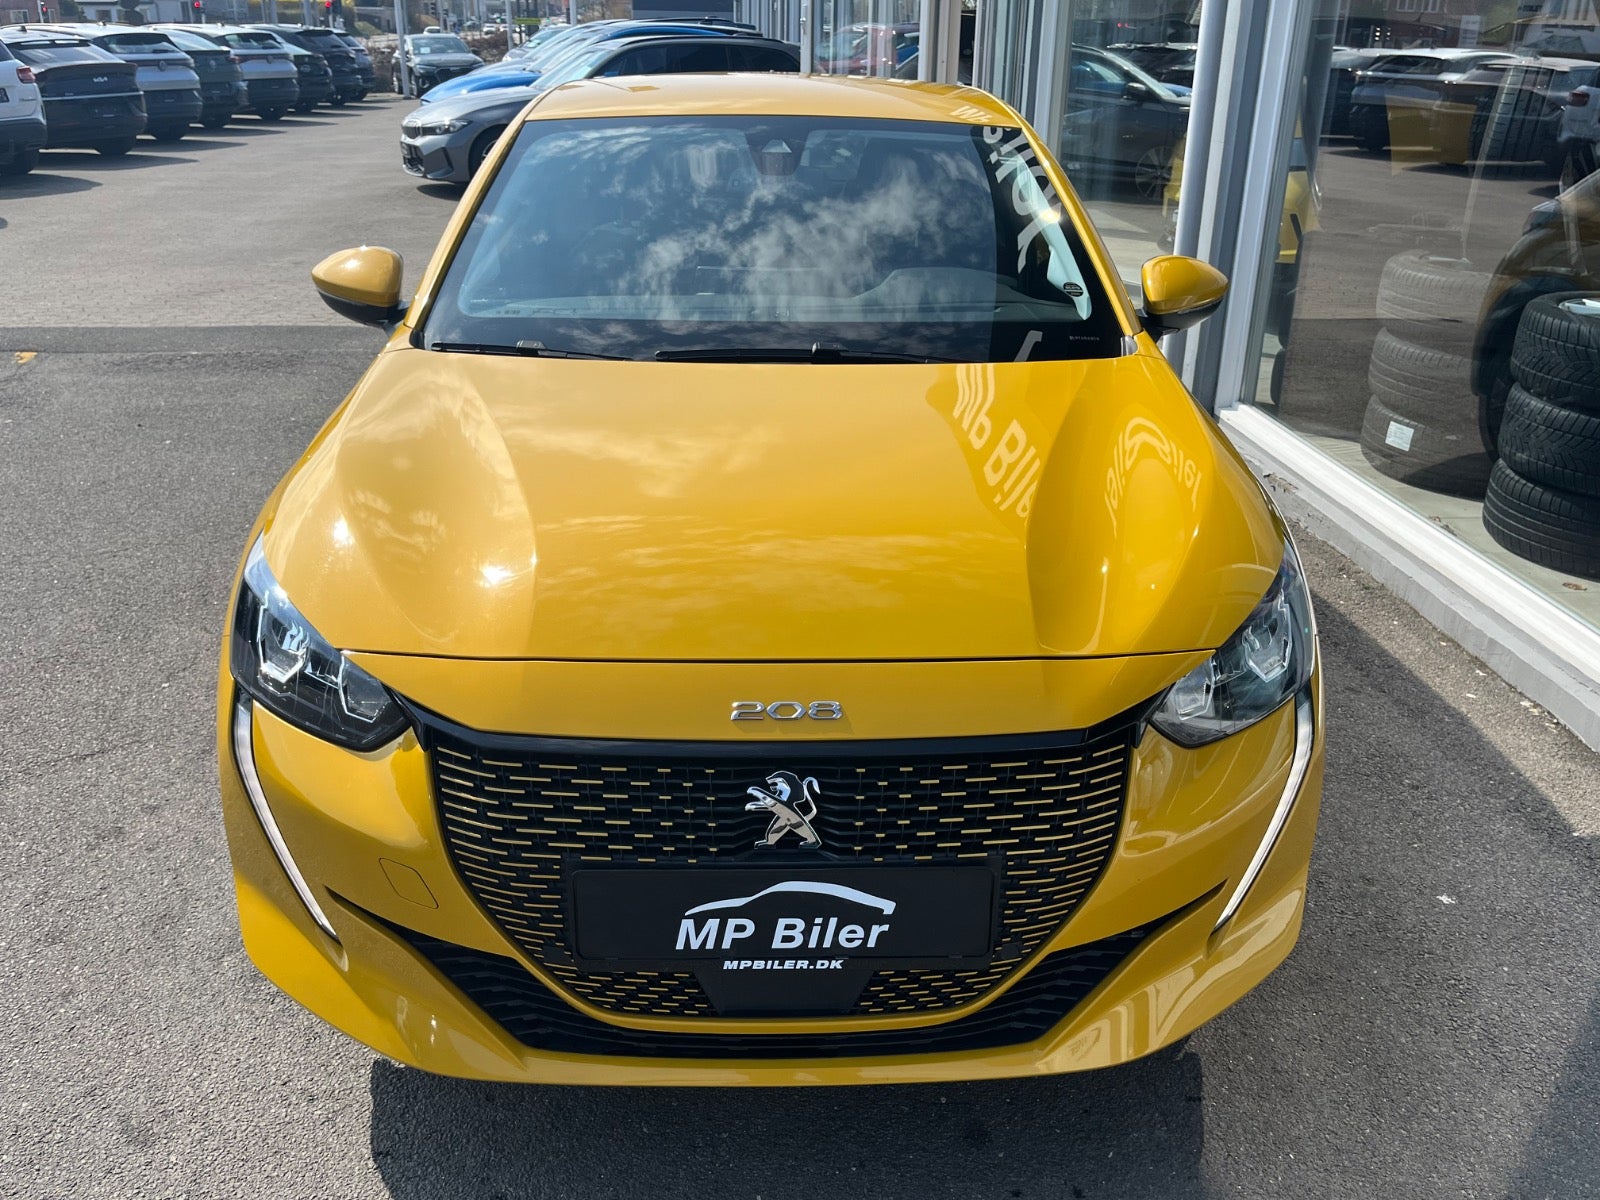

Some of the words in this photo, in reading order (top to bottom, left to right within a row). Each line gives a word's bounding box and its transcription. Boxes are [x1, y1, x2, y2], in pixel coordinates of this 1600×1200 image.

[730, 700, 843, 720] 208
[675, 917, 756, 950] MP
[771, 916, 890, 949] Biler
[722, 959, 844, 970] MPBILER.DK
